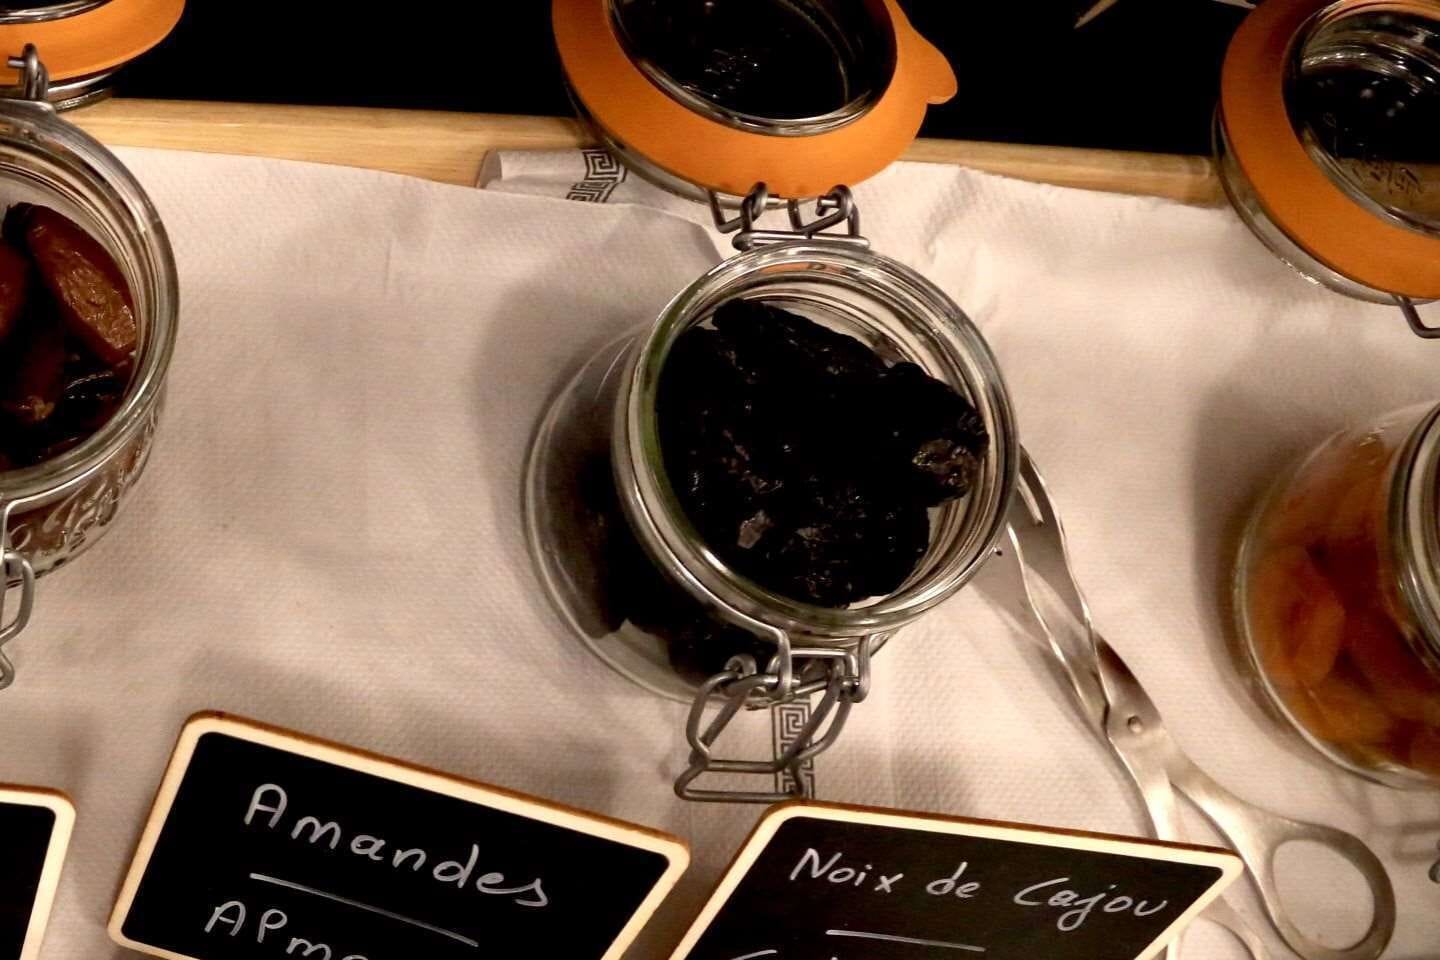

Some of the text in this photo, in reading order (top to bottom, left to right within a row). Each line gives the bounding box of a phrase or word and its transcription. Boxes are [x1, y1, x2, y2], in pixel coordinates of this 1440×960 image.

[244, 783, 548, 907] Amandes
[789, 847, 1167, 932] Noix de Cajou
